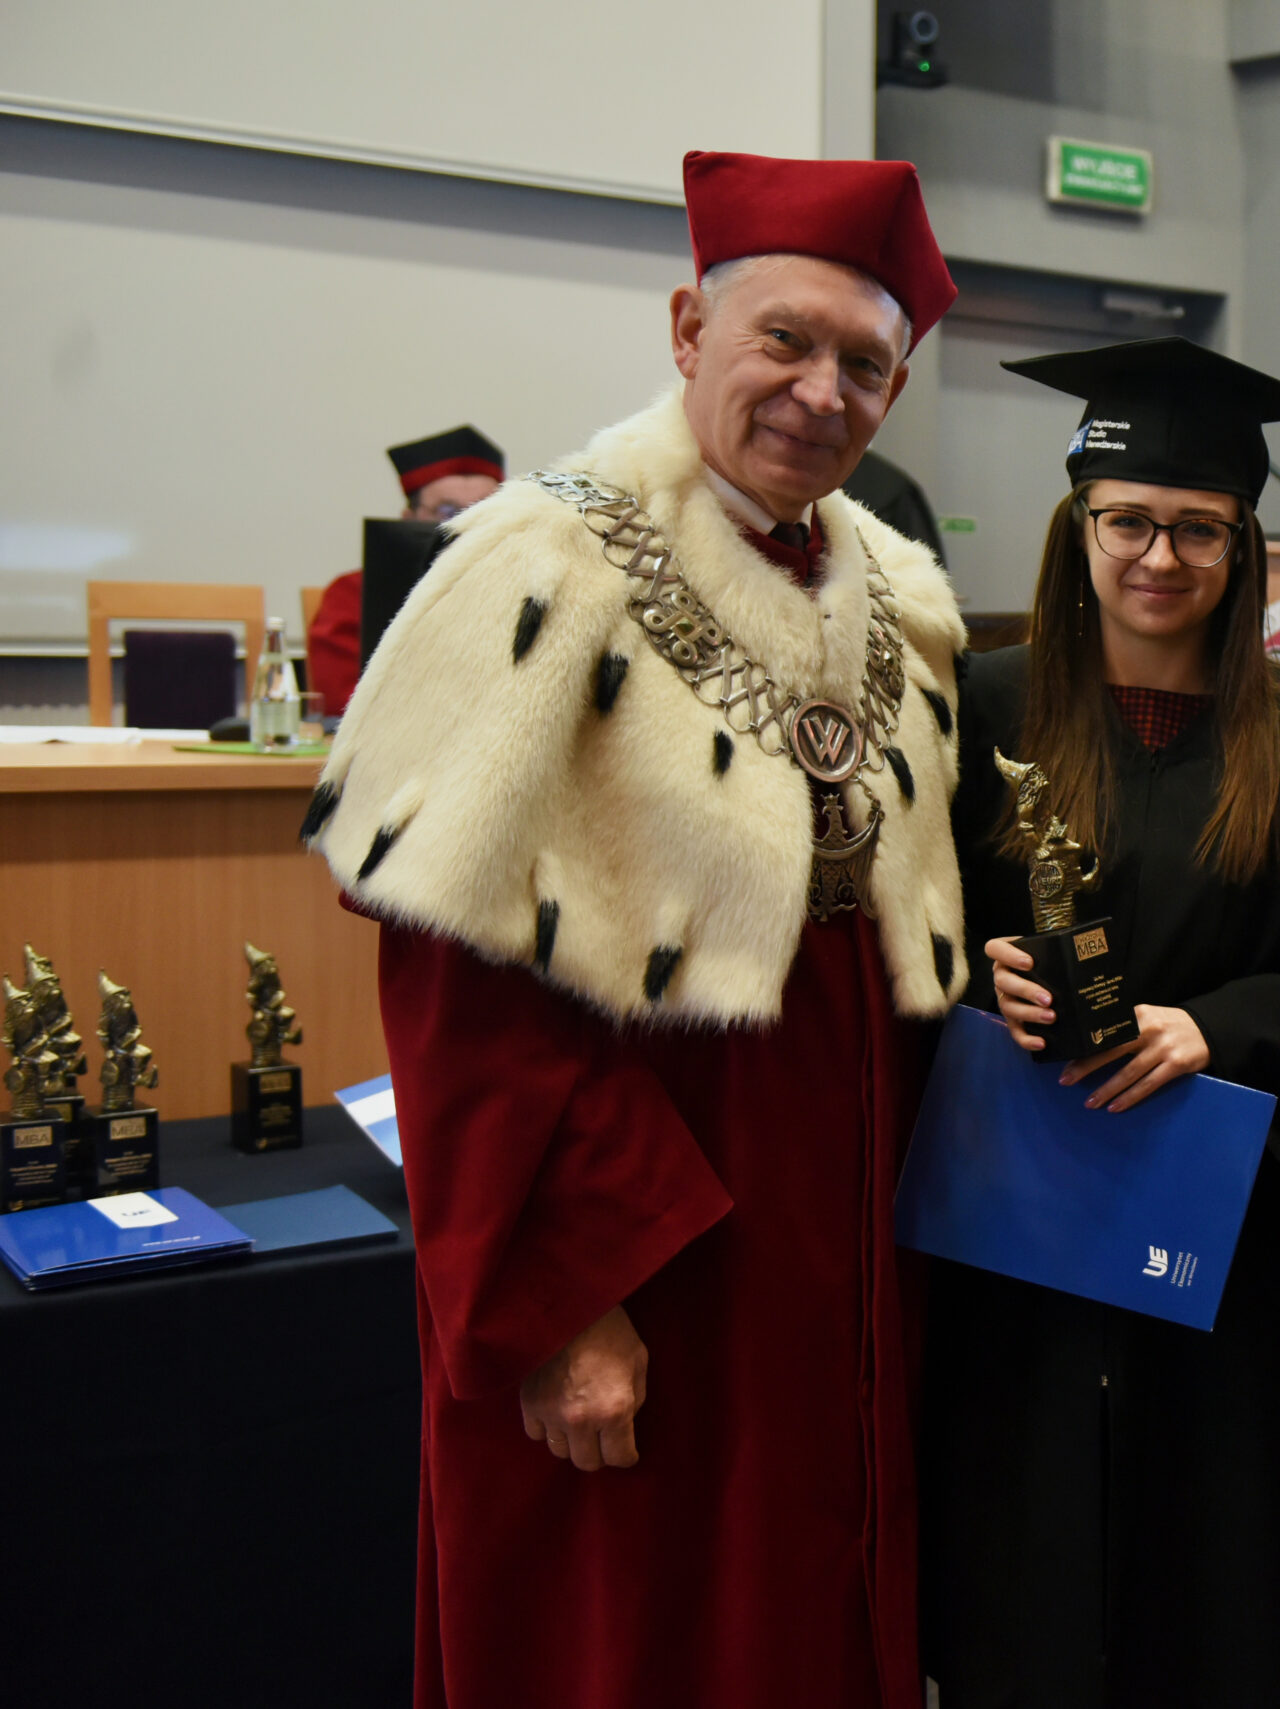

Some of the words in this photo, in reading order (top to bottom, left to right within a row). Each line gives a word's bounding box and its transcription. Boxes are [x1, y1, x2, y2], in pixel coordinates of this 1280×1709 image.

[1076, 938, 1107, 958] MBA
[16, 1133, 49, 1146] MBA
[1142, 1245, 1168, 1277] UE
